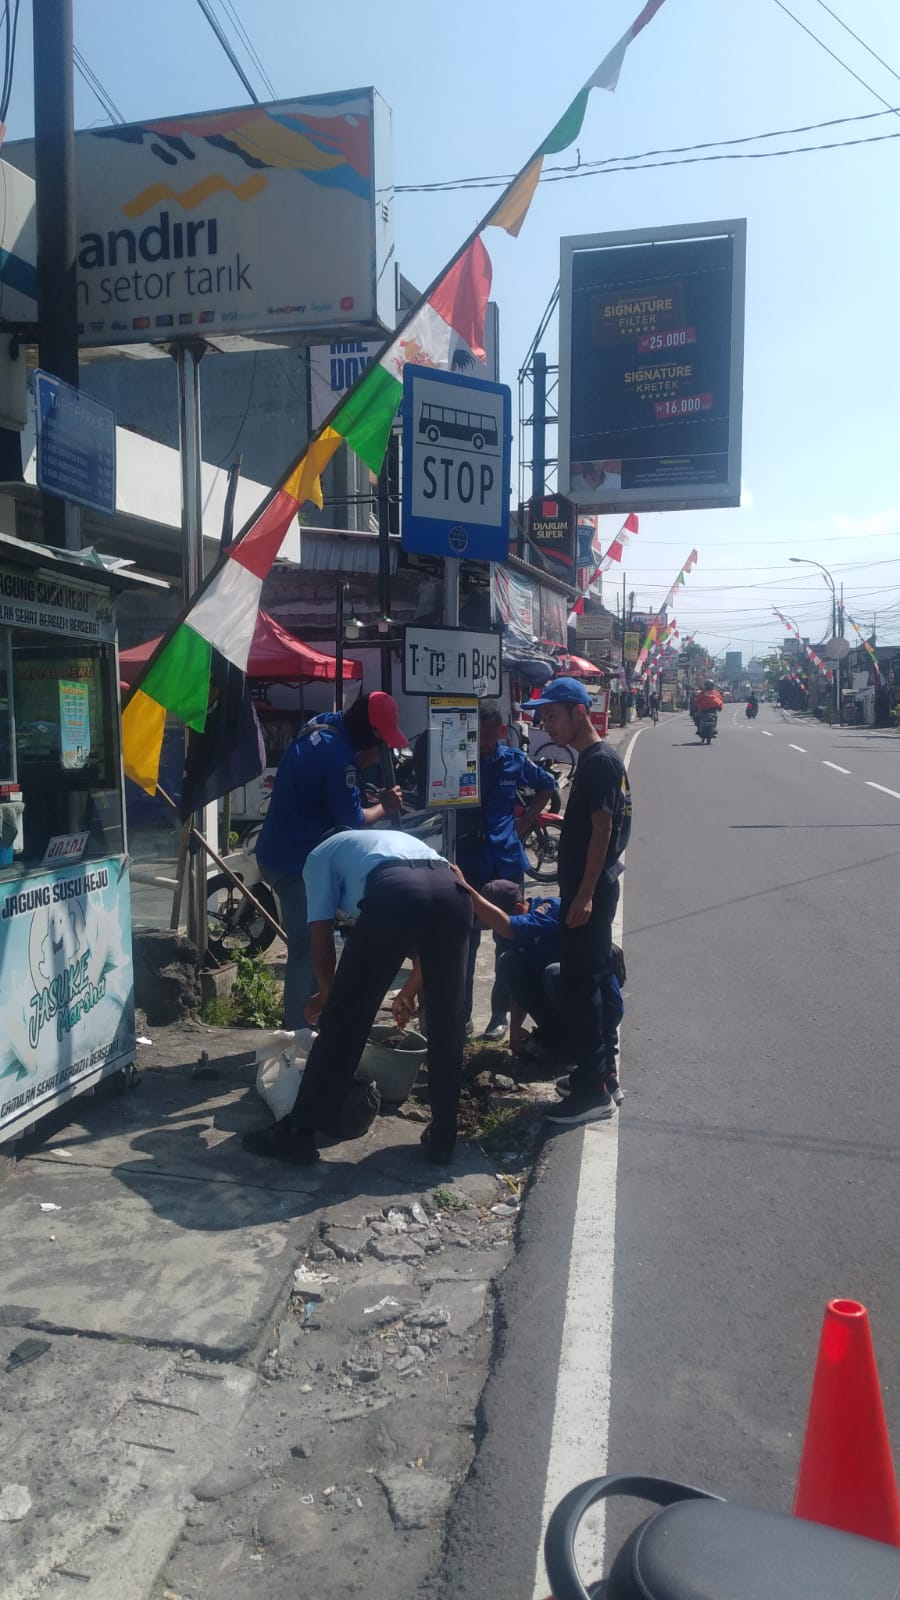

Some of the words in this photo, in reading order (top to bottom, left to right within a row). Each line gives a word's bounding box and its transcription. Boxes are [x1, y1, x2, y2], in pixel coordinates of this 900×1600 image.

[78, 211, 217, 270] andiri
[100, 270, 176, 305] setor
[184, 253, 253, 297] tarik
[603, 299, 673, 318] SIGNATURE
[619, 315, 657, 328] FILTER
[649, 332, 687, 350] 25.000
[623, 366, 692, 383] SIGNATURE
[636, 380, 679, 392] KRETEK
[665, 398, 701, 414] 16.000
[423, 455, 494, 505] STOP
[533, 521, 568, 531] DJARUM
[536, 530, 564, 539] SUPER
[2, 886, 51, 919] JAGUNG
[52, 876, 81, 904] SUSU
[83, 868, 108, 894] KEJU
[29, 948, 91, 1049] JASUKE
[56, 976, 106, 1042] Marsha
